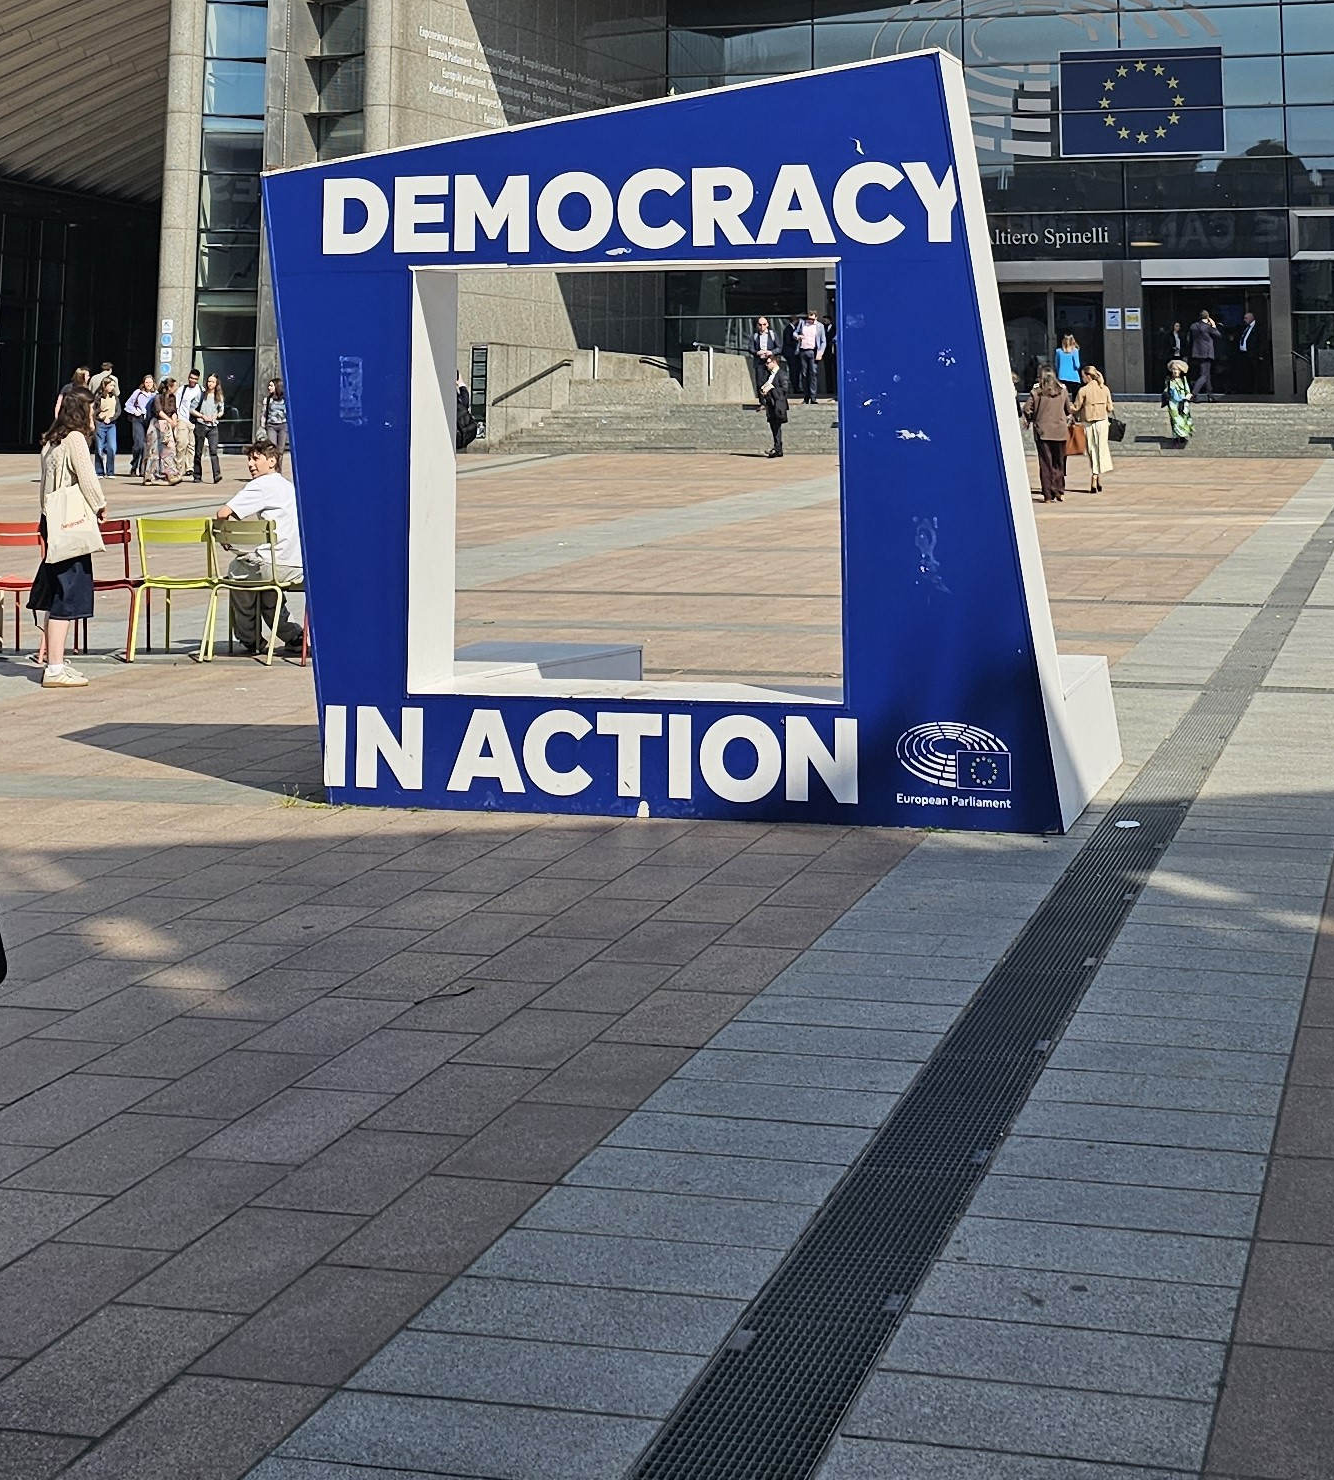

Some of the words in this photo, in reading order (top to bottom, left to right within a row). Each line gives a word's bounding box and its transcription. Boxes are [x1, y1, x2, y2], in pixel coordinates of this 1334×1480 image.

[322, 160, 959, 256] DEMOCRACY
[990, 229, 1039, 245] ltiero
[1044, 226, 1109, 249] Spinelli
[323, 704, 424, 791] IN
[446, 708, 859, 806] ACTION
[896, 792, 948, 807] European
[951, 795, 1012, 809] Parliament
